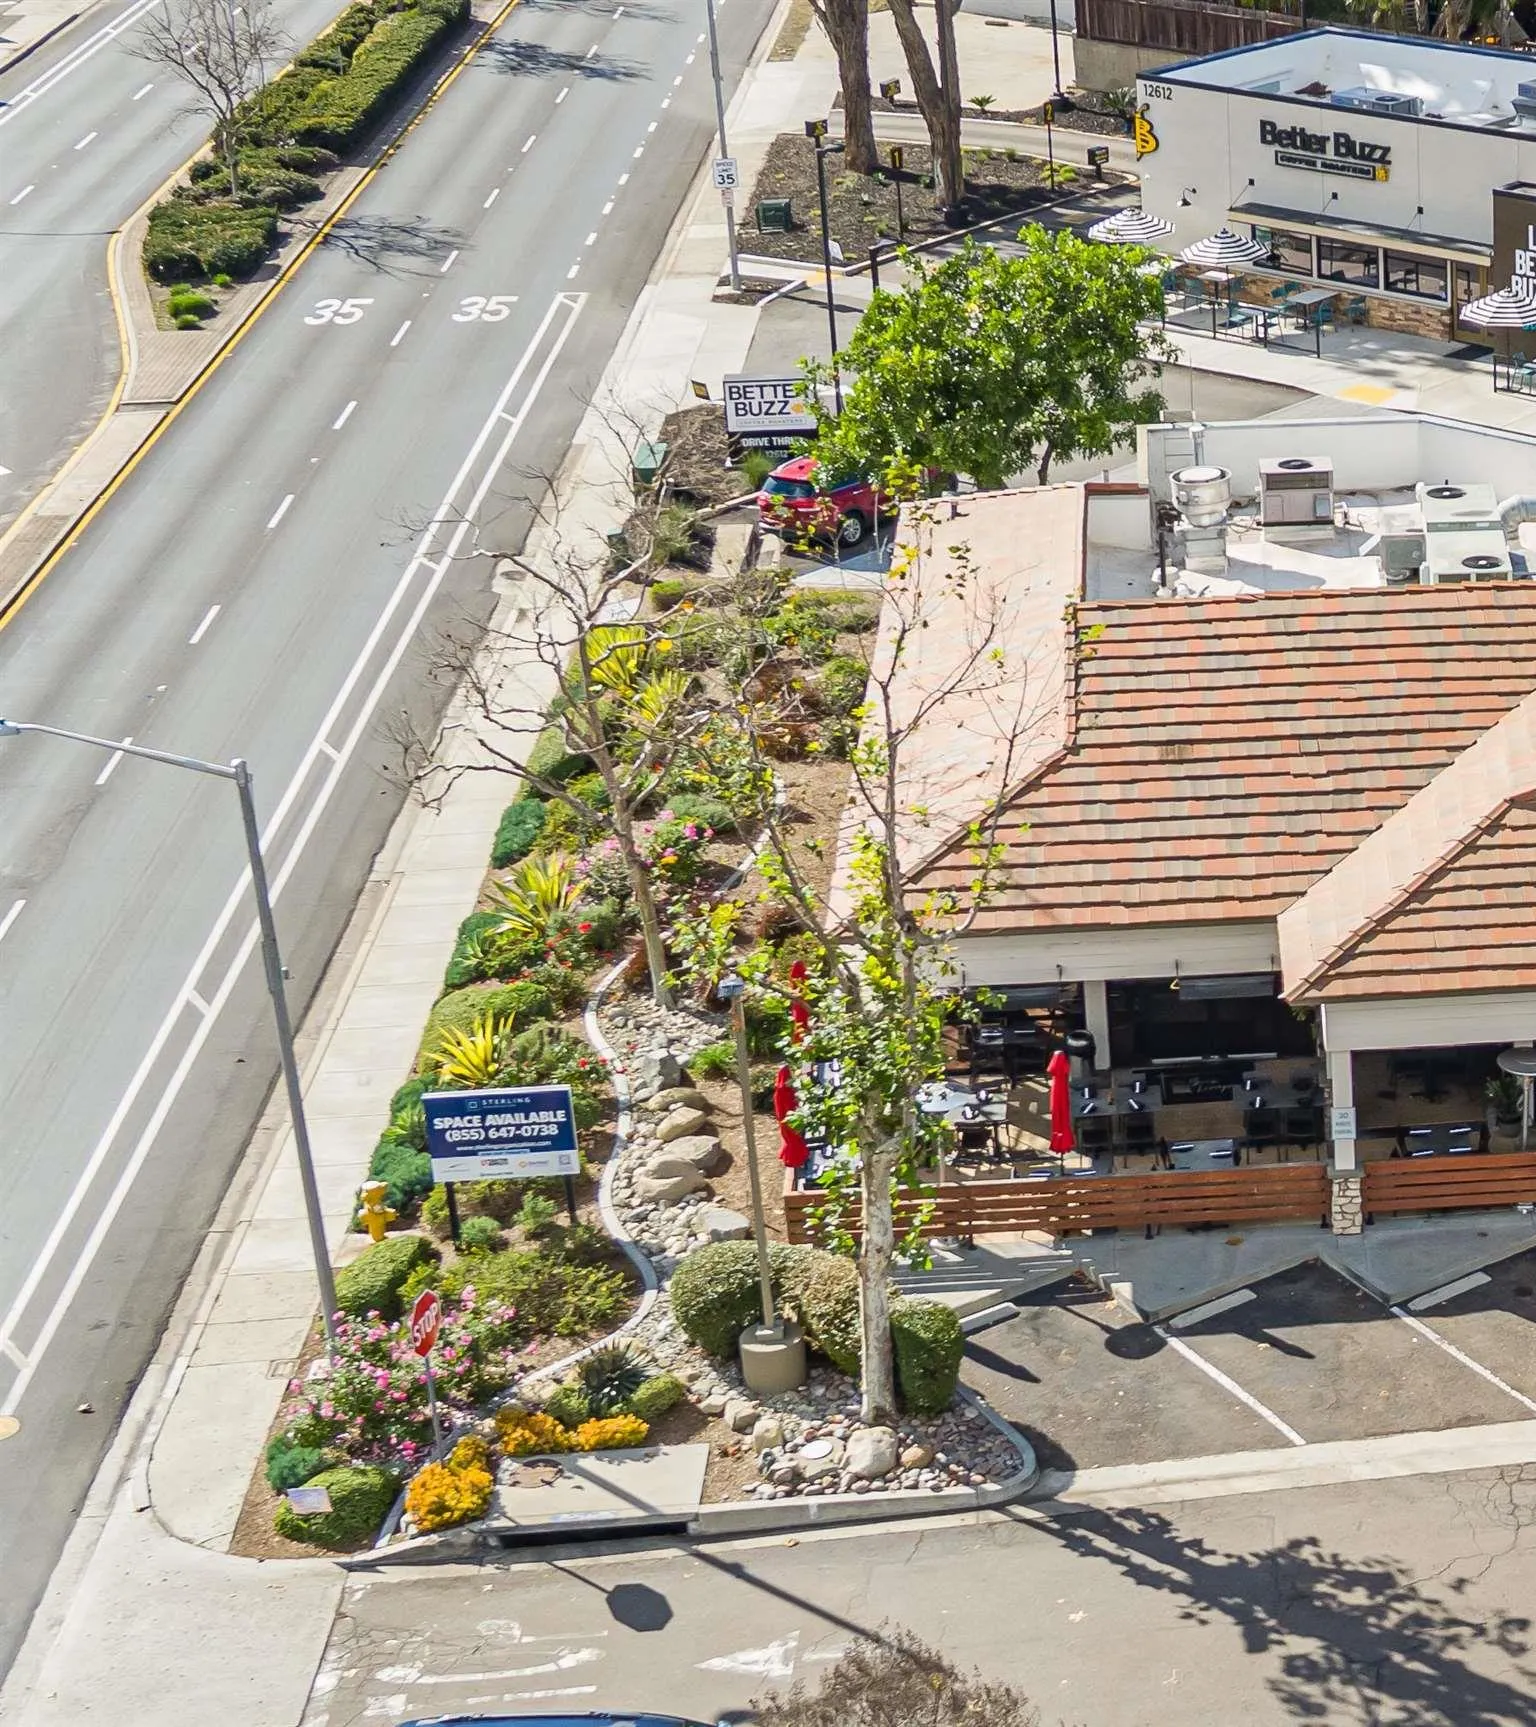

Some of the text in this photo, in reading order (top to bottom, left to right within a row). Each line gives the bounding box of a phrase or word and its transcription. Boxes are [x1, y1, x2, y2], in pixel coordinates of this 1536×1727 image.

[1143, 84, 1173, 100] 12612
[1259, 119, 1392, 165] Better Buzz
[717, 173, 736, 185] 35
[303, 298, 376, 325] 35
[451, 295, 520, 322] 35
[728, 383, 795, 400] BETTE
[735, 400, 791, 417] BUZZ
[742, 437, 770, 447] DRIVE
[481, 1096, 531, 1106] STERLING
[433, 1110, 567, 1130] SPACE AVAILABLE
[445, 1123, 559, 1143] (855) 647-0738
[413, 1302, 438, 1347] STOP
